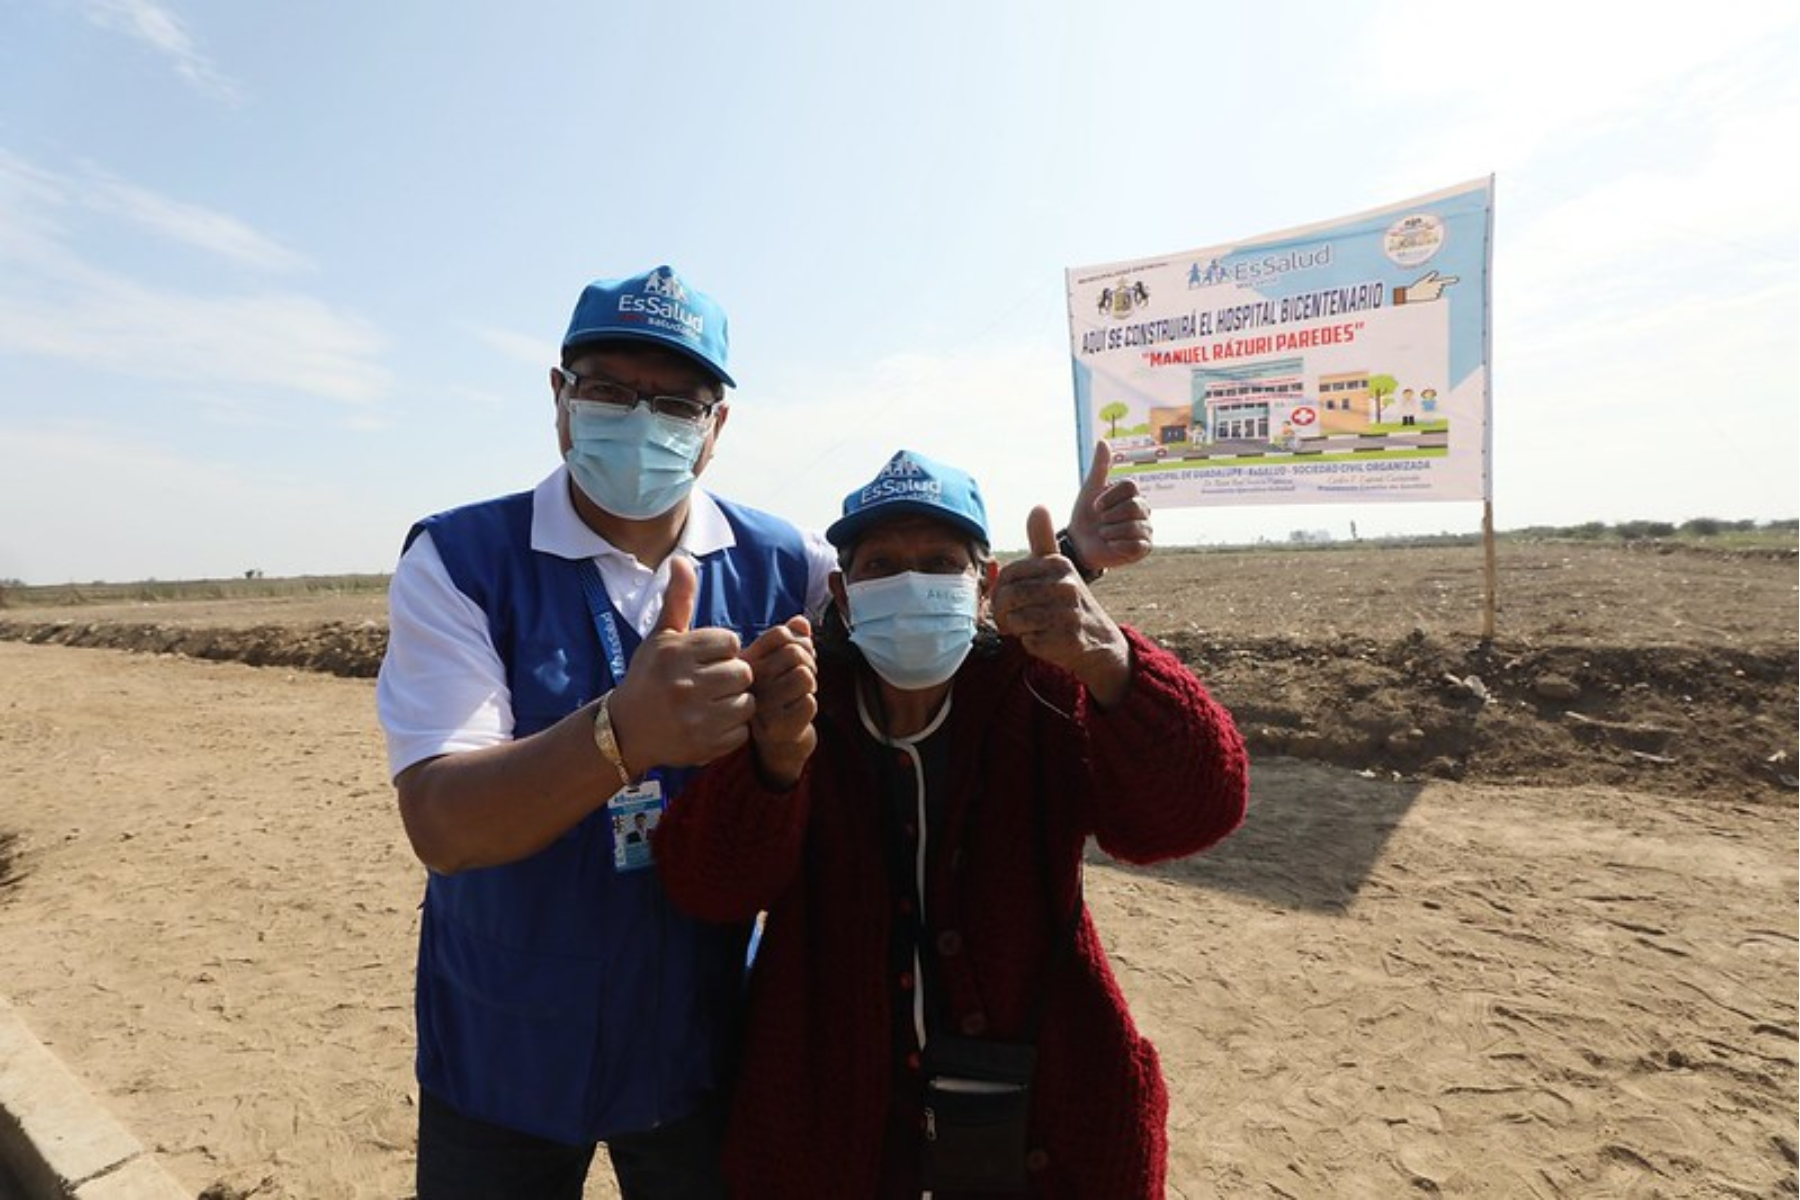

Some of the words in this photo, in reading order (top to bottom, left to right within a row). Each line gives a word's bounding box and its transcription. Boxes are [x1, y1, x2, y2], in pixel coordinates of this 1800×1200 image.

[1235, 245, 1330, 281] EsSalud
[619, 295, 703, 333] EsSalud
[1082, 325, 1106, 354] AQUÍ
[1108, 327, 1123, 350] SE
[1125, 310, 1196, 345] CONSTRUIRÁ
[1200, 311, 1212, 336] EL
[1216, 300, 1277, 334] HOSPITAL
[1281, 283, 1384, 323] BICENTENARIO
[1213, 337, 1273, 360] RÁZURI
[1293, 463, 1338, 475] SOCIEDAD
[1341, 463, 1364, 473] CIVIL
[1366, 460, 1431, 471] ORGANIZADA
[862, 479, 942, 504] EsSalud
